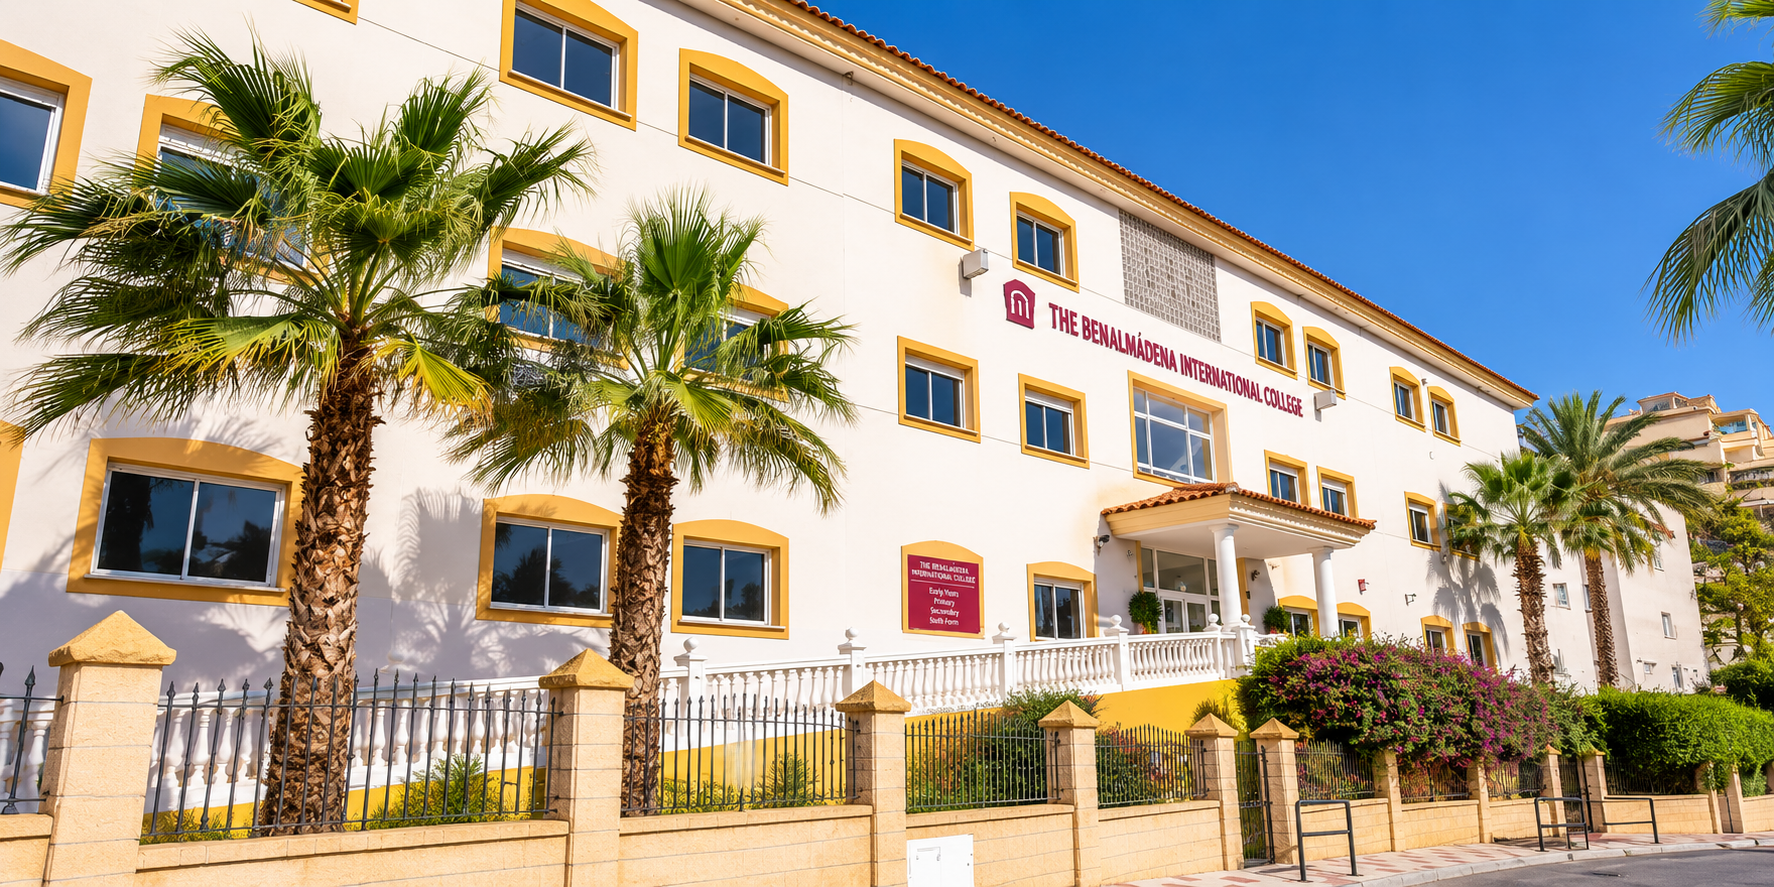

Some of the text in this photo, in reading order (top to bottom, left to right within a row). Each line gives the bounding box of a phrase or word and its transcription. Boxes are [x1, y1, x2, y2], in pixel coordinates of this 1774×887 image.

[1048, 302, 1303, 417] THE BENALMÁDENA INTERNATIONAL COLLEGE
[929, 587, 943, 597] Early
